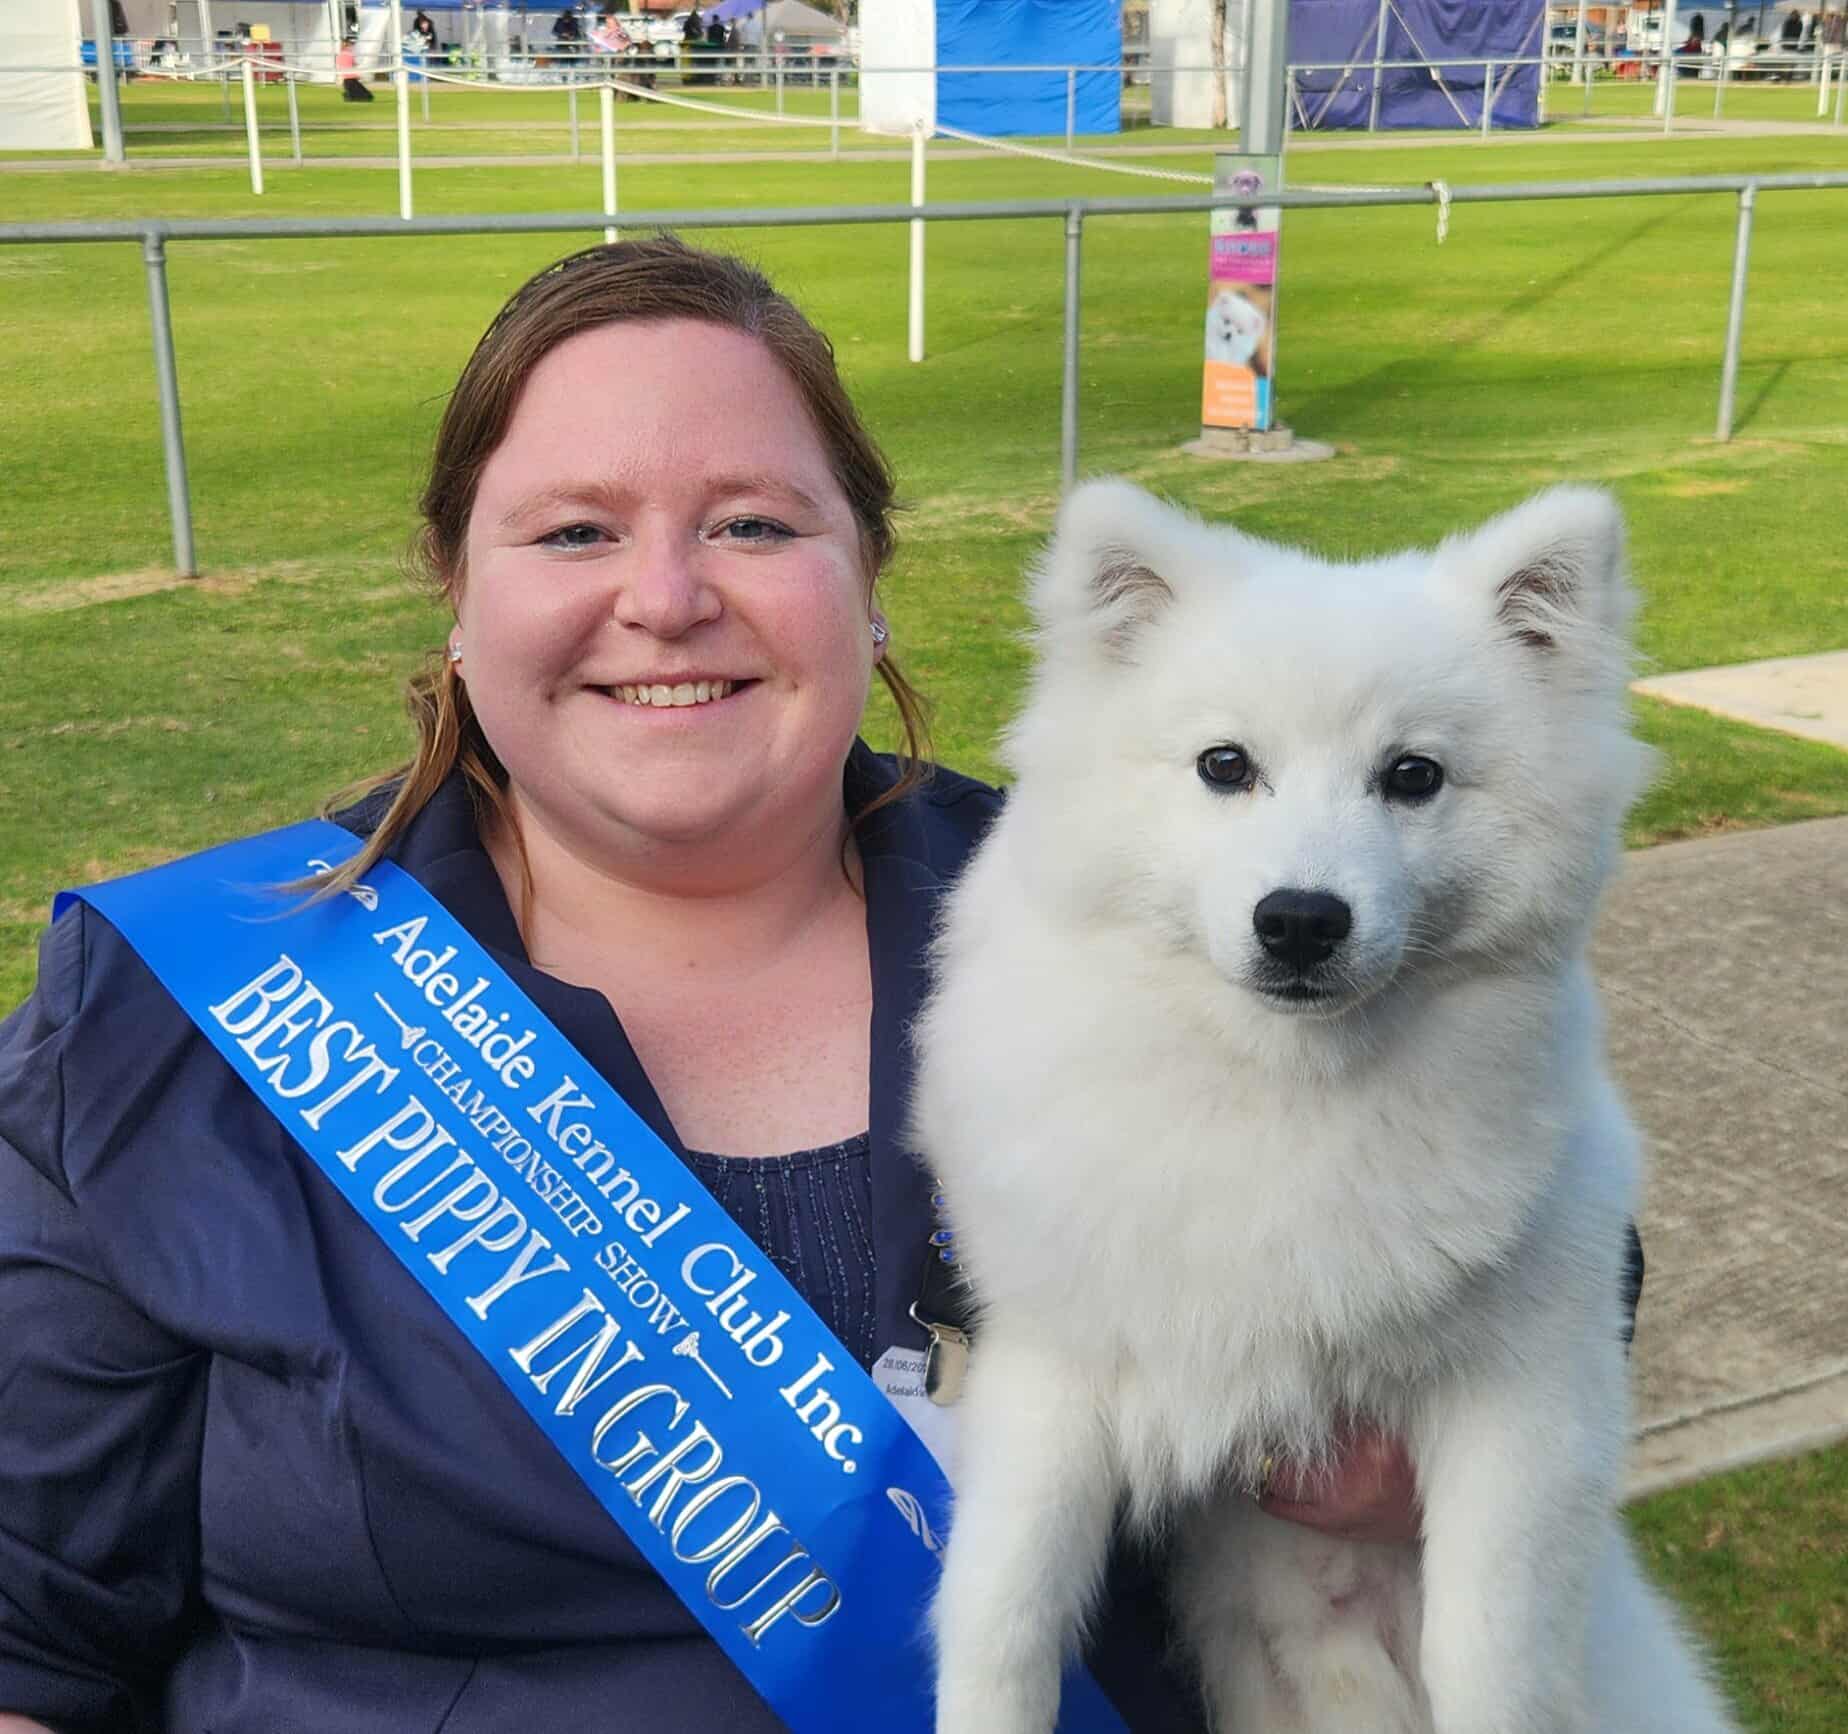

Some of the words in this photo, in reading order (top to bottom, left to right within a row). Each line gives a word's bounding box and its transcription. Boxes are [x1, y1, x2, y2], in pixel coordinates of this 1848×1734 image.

[208, 953, 400, 1131] BEST
[336, 1094, 571, 1320] PUPPY
[508, 1287, 645, 1416] IN
[591, 1384, 841, 1648] GROUP
[372, 916, 536, 1089] Adelaide
[526, 1074, 692, 1248] Kennel
[681, 1242, 791, 1367] Club
[779, 1352, 863, 1473] Inc.
[413, 1039, 603, 1237] CHAMPIONSHIP
[594, 1241, 689, 1334] SHOW
